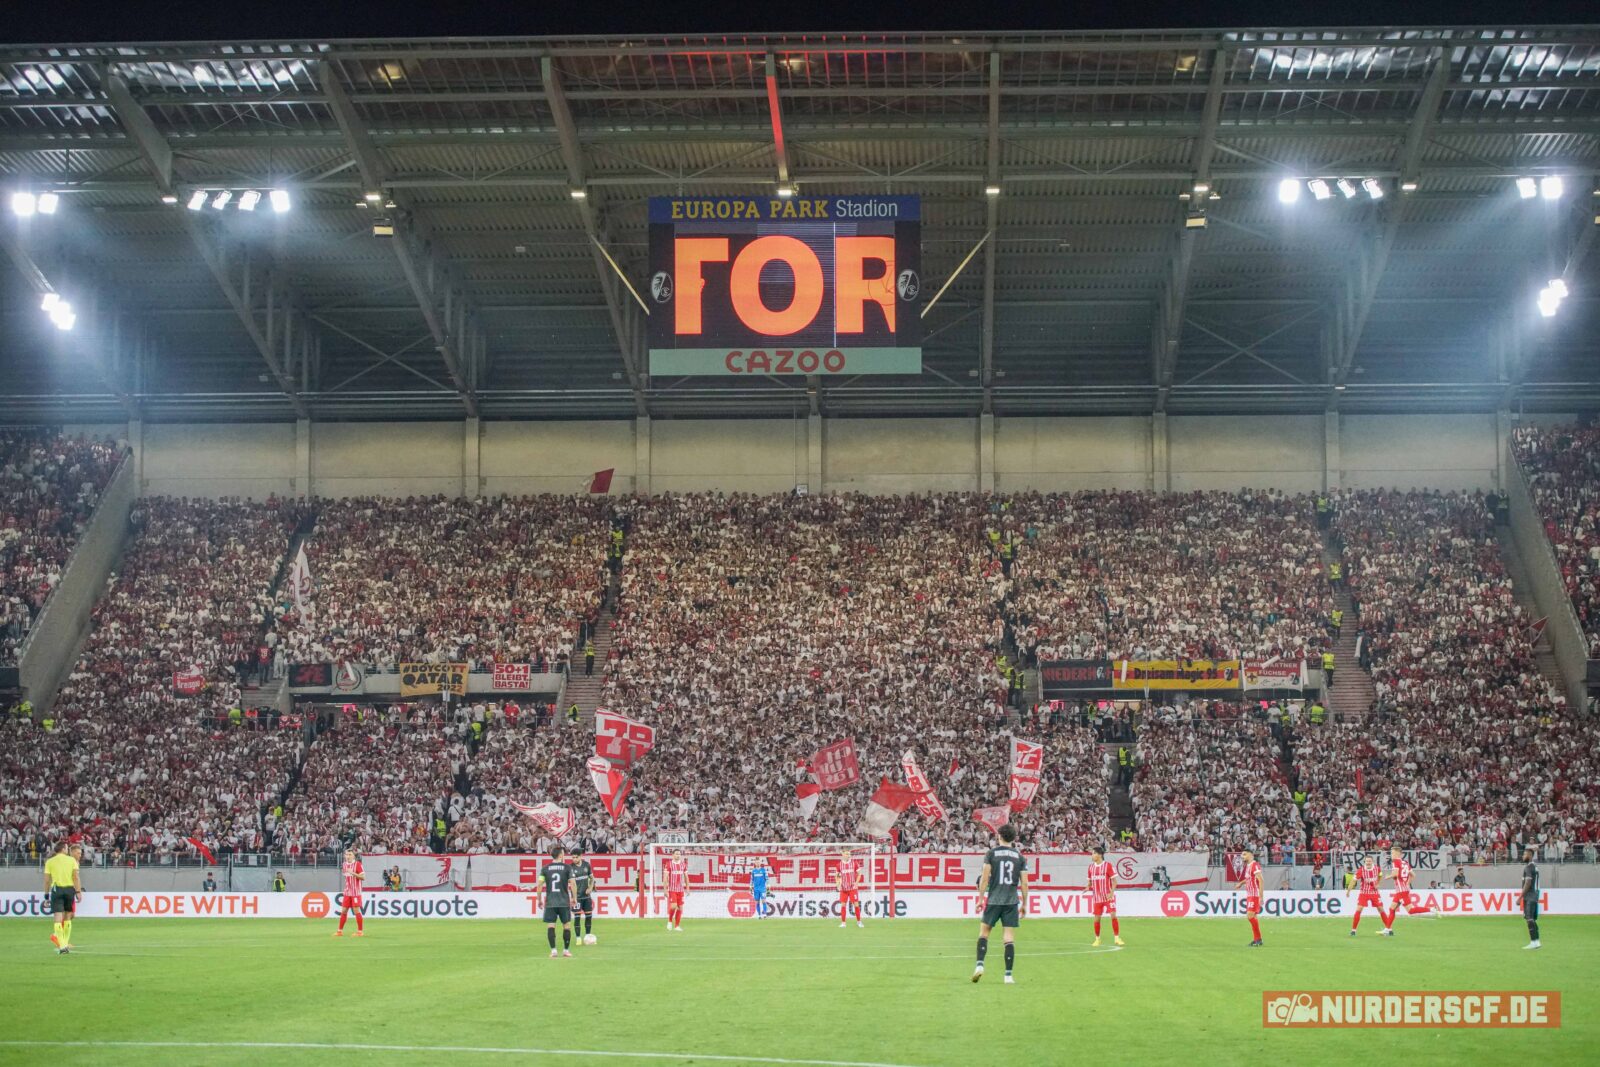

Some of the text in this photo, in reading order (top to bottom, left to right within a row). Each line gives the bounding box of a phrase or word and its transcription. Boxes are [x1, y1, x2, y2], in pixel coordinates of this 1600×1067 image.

[671, 199, 898, 219] EUROPA PARK Stadion
[725, 350, 846, 373] CAZOO
[495, 664, 529, 674] 50+1
[402, 672, 464, 688] QATAR
[998, 860, 1014, 884] 13
[551, 873, 560, 892] 2
[104, 896, 259, 914] TRADE WITH
